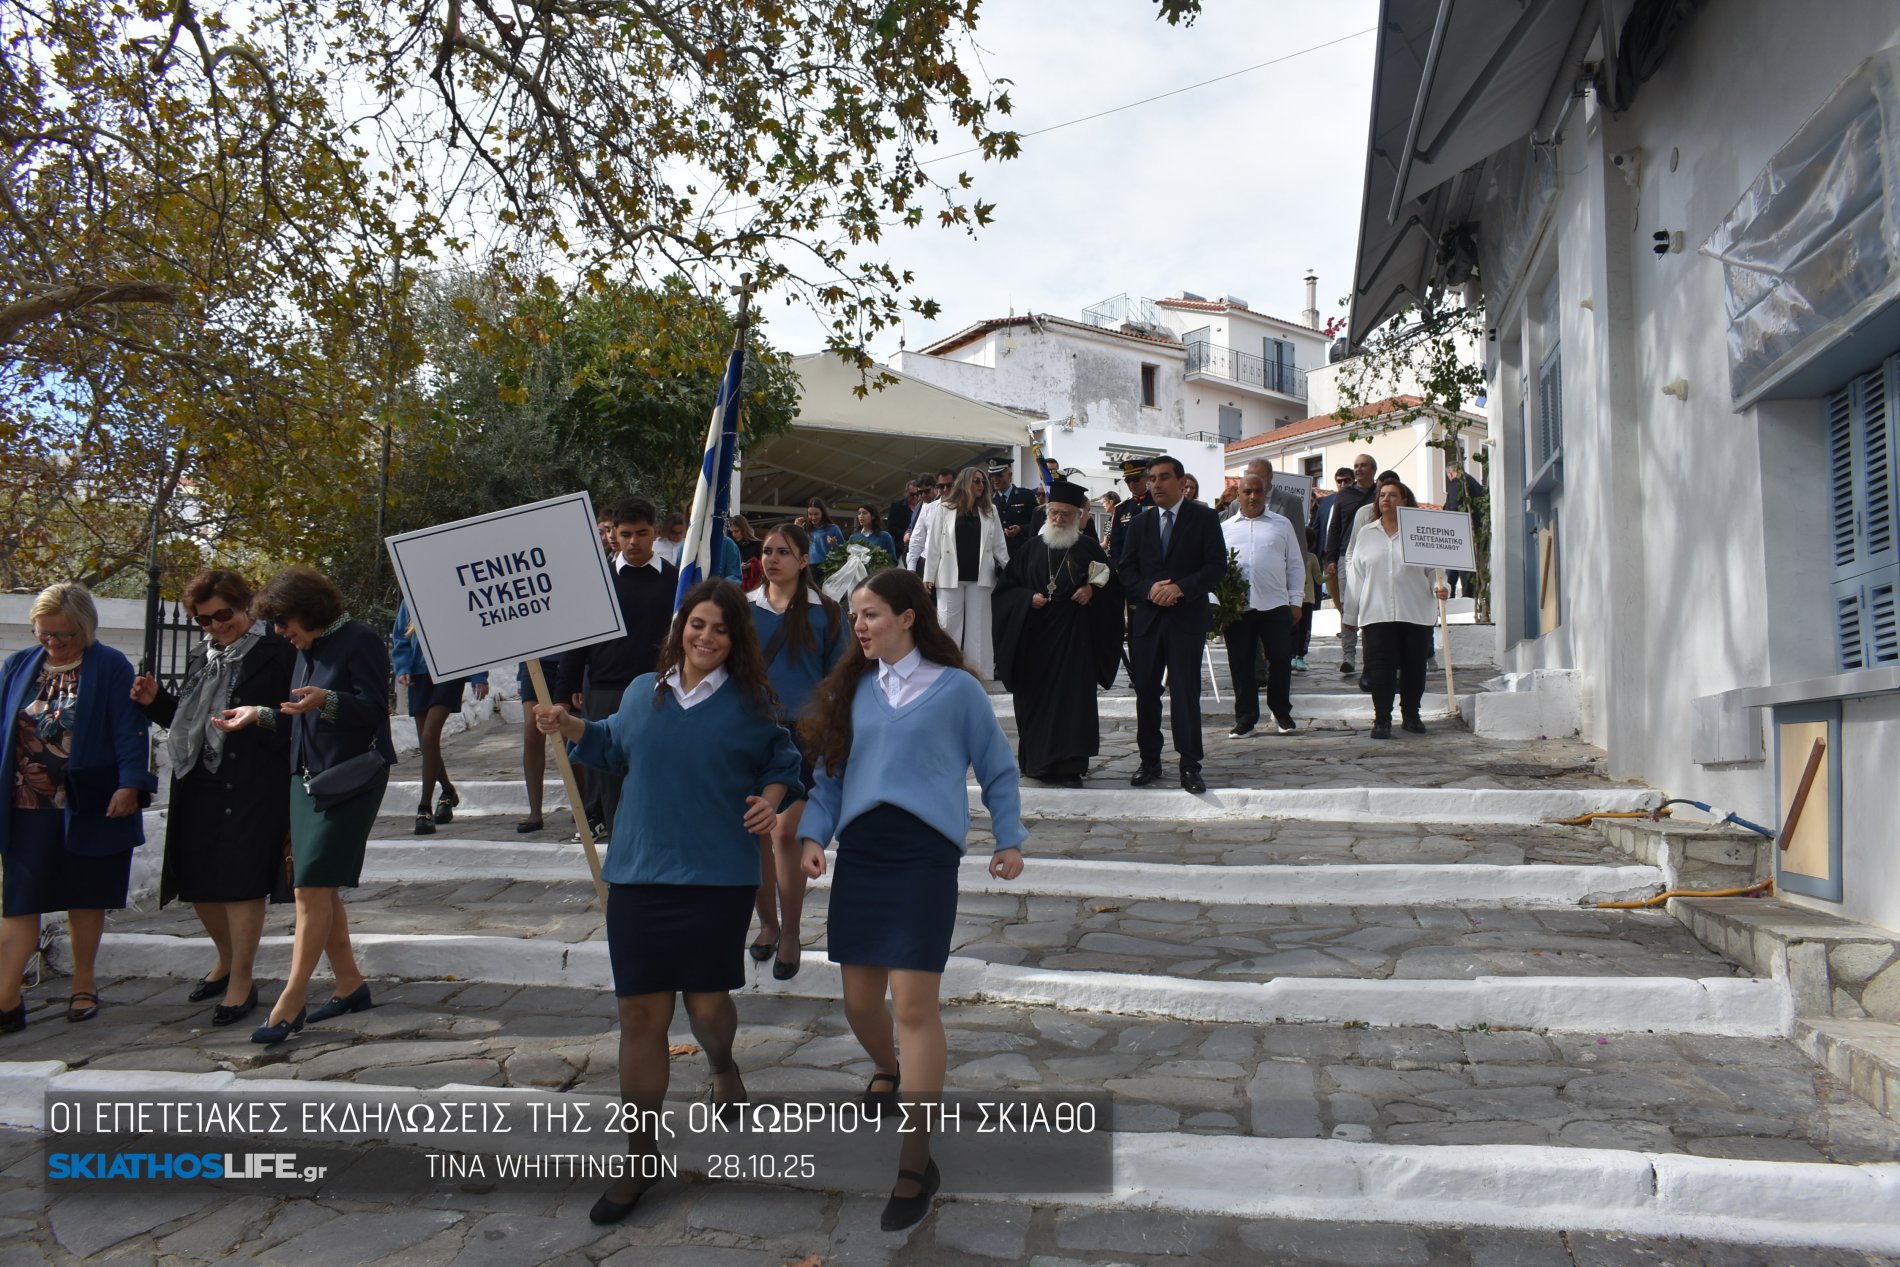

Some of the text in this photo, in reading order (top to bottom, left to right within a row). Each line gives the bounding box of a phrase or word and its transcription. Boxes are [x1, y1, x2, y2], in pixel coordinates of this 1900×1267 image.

[1410, 534, 1463, 545] ΕΠΑΓΓΕΛΜΑΤΙΚΟ
[1416, 526, 1455, 537] ΕΣΠΕΡΙΝΟ
[1415, 541, 1460, 551] ΛΥΚΕΙΟ ΣΚΙΑΘΟΥ
[456, 547, 546, 587] ΓΕΝΙΚΟ
[468, 572, 553, 612] ΛΥΚΕΙΟ
[479, 596, 551, 627] ΣΚΙΑΘΟΥ
